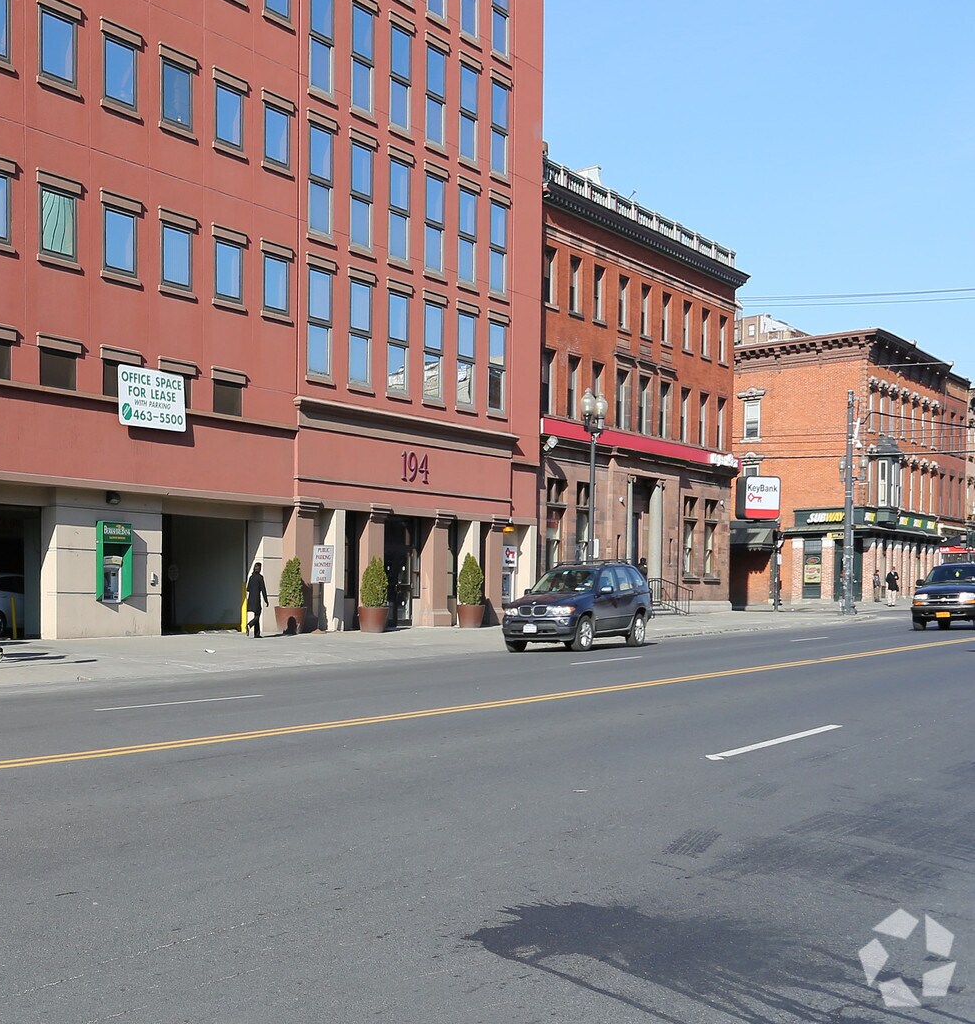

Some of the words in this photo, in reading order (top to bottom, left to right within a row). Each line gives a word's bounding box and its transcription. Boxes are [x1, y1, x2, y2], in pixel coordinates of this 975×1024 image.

[121, 371, 151, 386] OFFICE
[155, 376, 182, 391] SPACE
[128, 385, 146, 398] FOR
[150, 389, 176, 403] LEASE
[134, 399, 148, 407] WITH
[148, 401, 171, 410] PARKING
[133, 409, 184, 425] 463-5500
[401, 450, 430, 485] 194
[747, 483, 778, 493] KeyBank
[806, 511, 845, 524] SUBWAY
